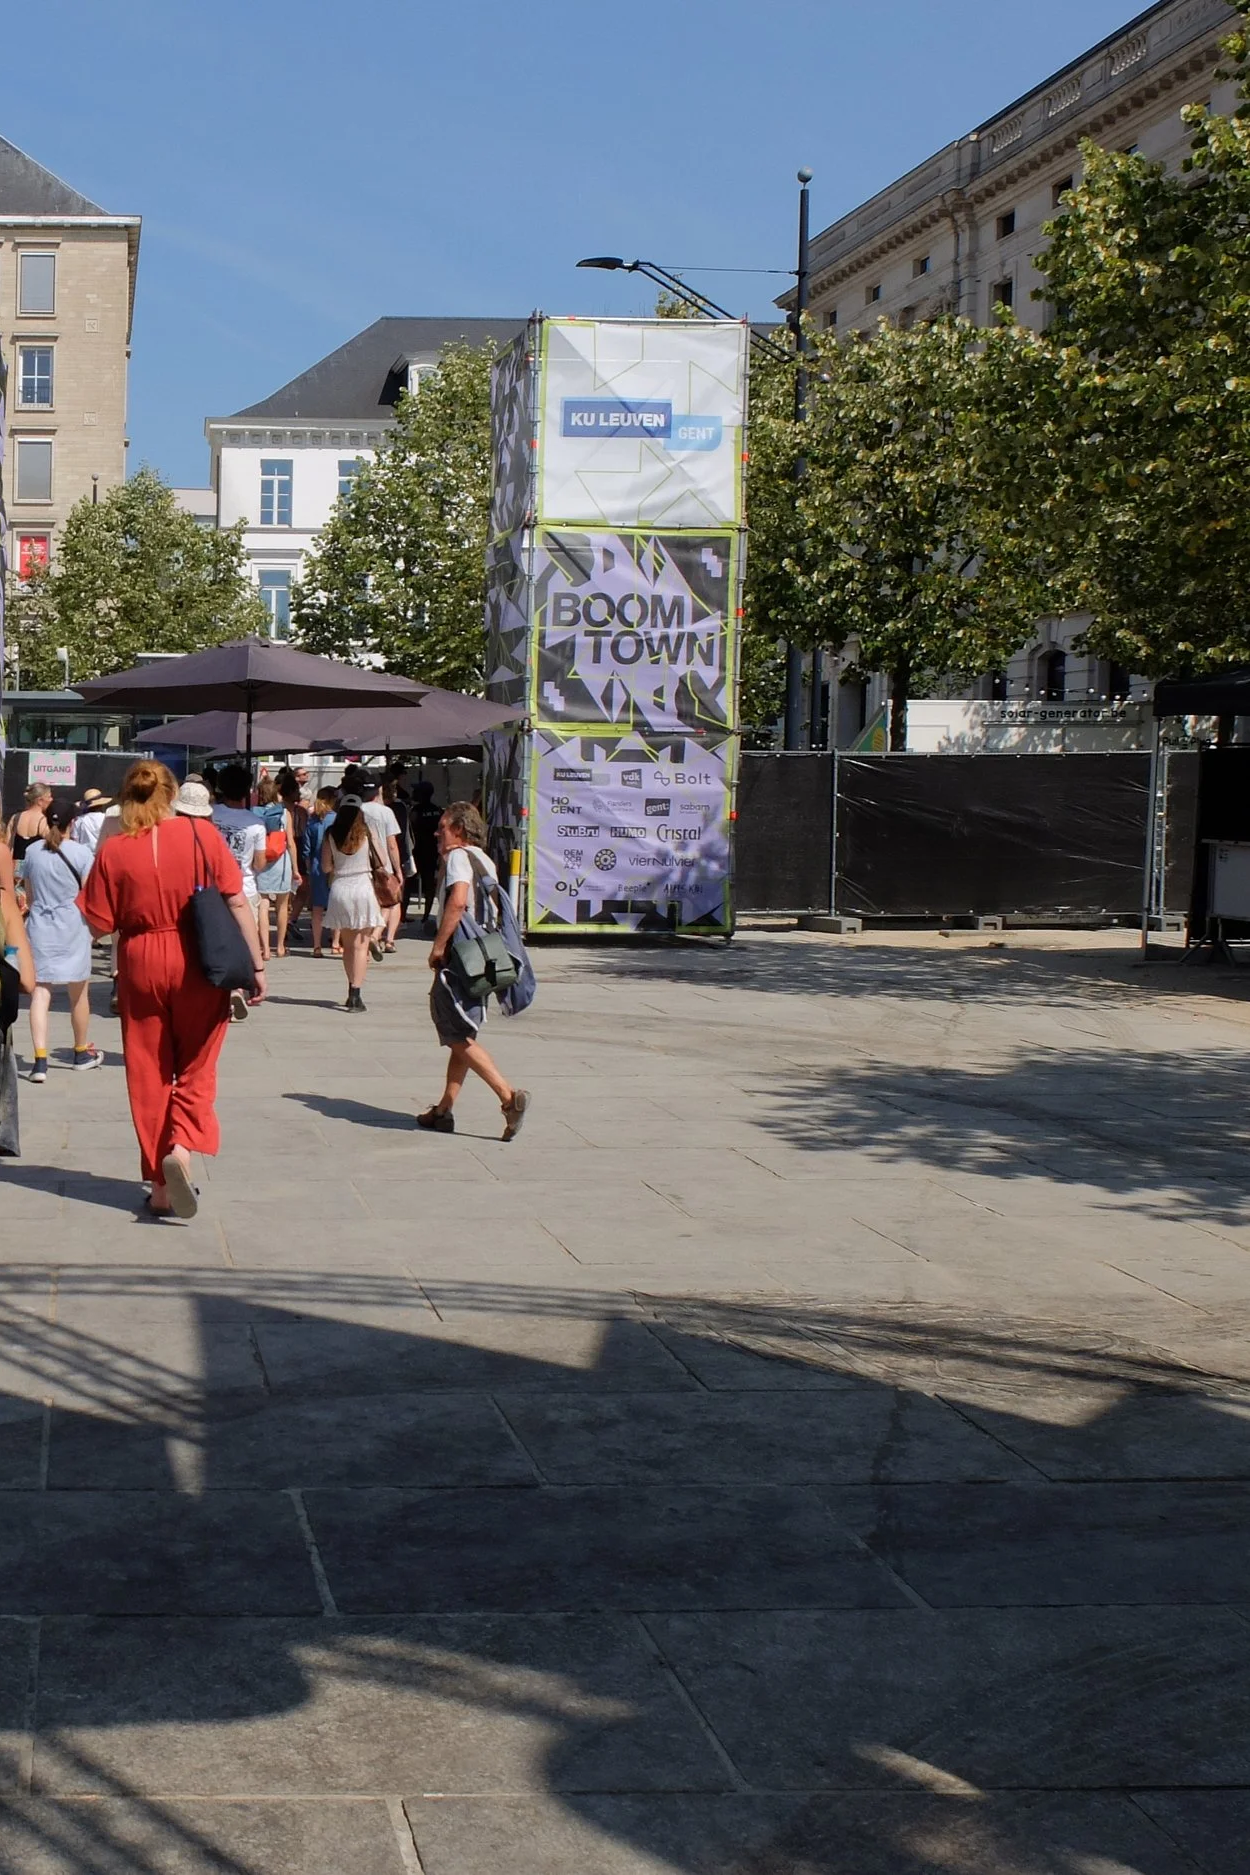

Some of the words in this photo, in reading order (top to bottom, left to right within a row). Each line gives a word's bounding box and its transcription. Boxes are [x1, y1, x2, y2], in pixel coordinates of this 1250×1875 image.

[571, 412, 595, 426] KU
[599, 412, 665, 427] LEUVEN
[678, 427, 715, 440] GENT
[553, 592, 686, 629] BOOM
[584, 630, 716, 667] TOWN
[33, 765, 71, 773] UITGANG
[622, 772, 640, 781] vdk
[675, 772, 711, 785] Bolt
[551, 797, 569, 805] HO
[680, 802, 710, 811] sabam
[551, 806, 582, 815] GENT
[557, 826, 599, 837] StuBru
[611, 827, 645, 838] HUMO
[656, 823, 701, 843] Cristal
